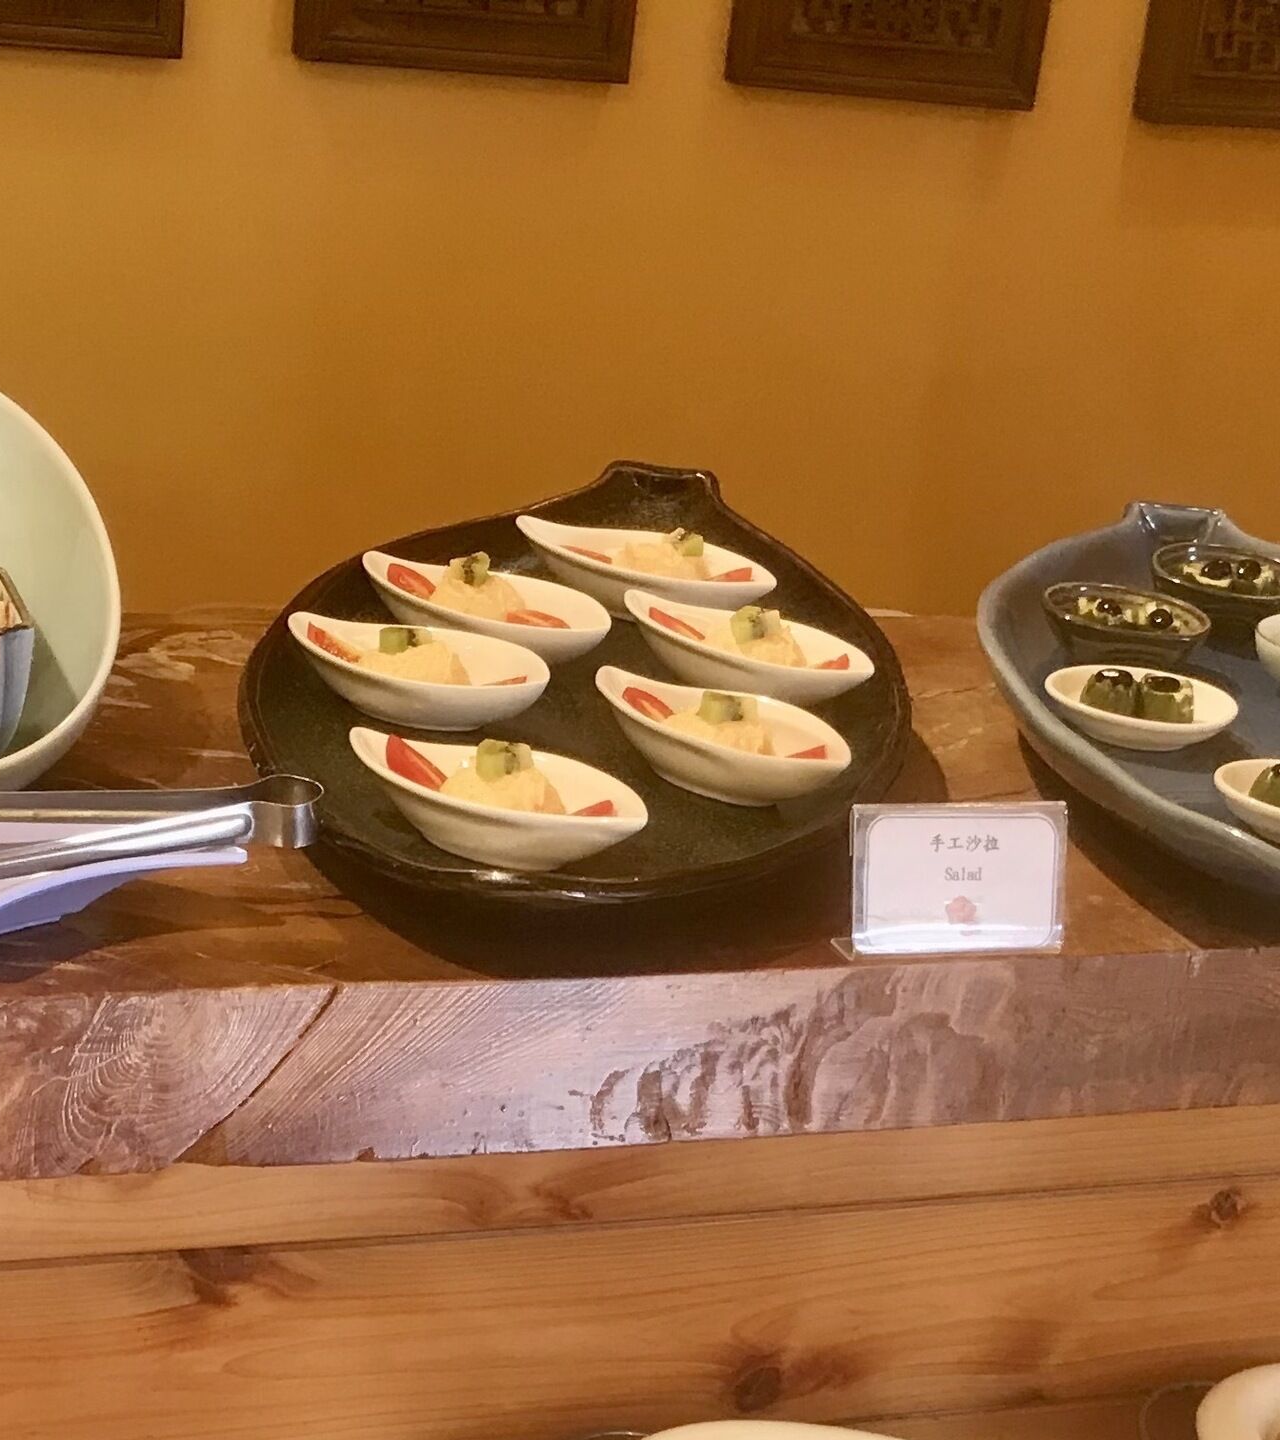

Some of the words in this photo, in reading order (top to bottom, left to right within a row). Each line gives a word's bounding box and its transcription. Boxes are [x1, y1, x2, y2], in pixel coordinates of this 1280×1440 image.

[930, 833, 1000, 852] 手工沙拉
[944, 867, 982, 882] Salad
